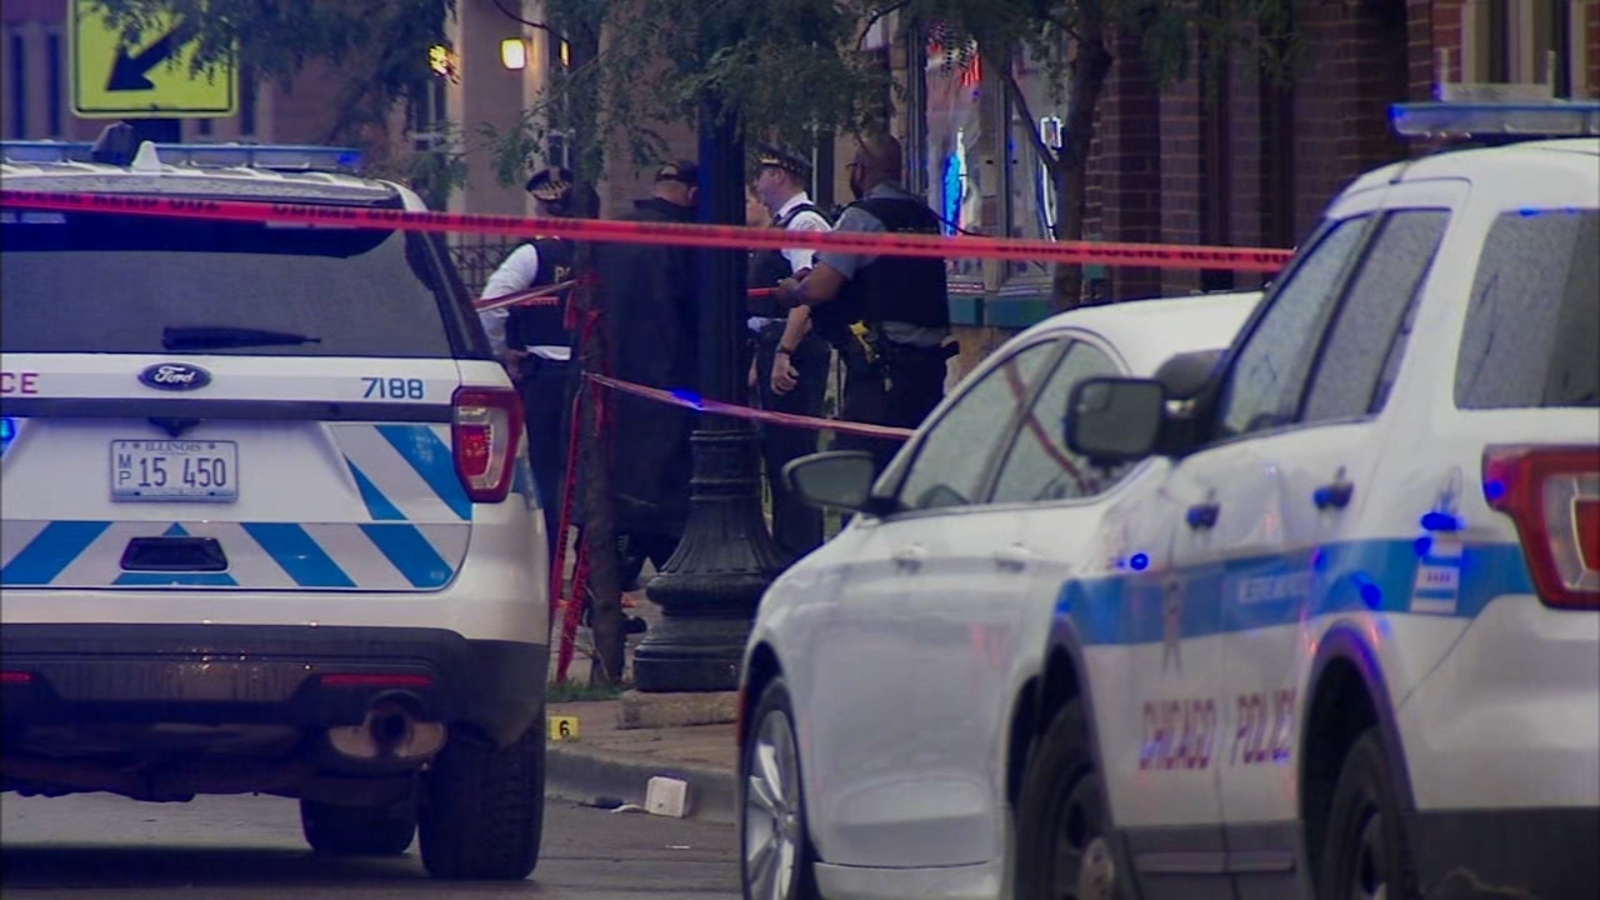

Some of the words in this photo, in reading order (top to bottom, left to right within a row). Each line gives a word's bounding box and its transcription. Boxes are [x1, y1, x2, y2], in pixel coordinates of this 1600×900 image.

[154, 365, 195, 384] Ford
[361, 377, 424, 400] 7188
[138, 457, 166, 487] 15
[183, 457, 226, 487] 450
[559, 720, 571, 738] 6
